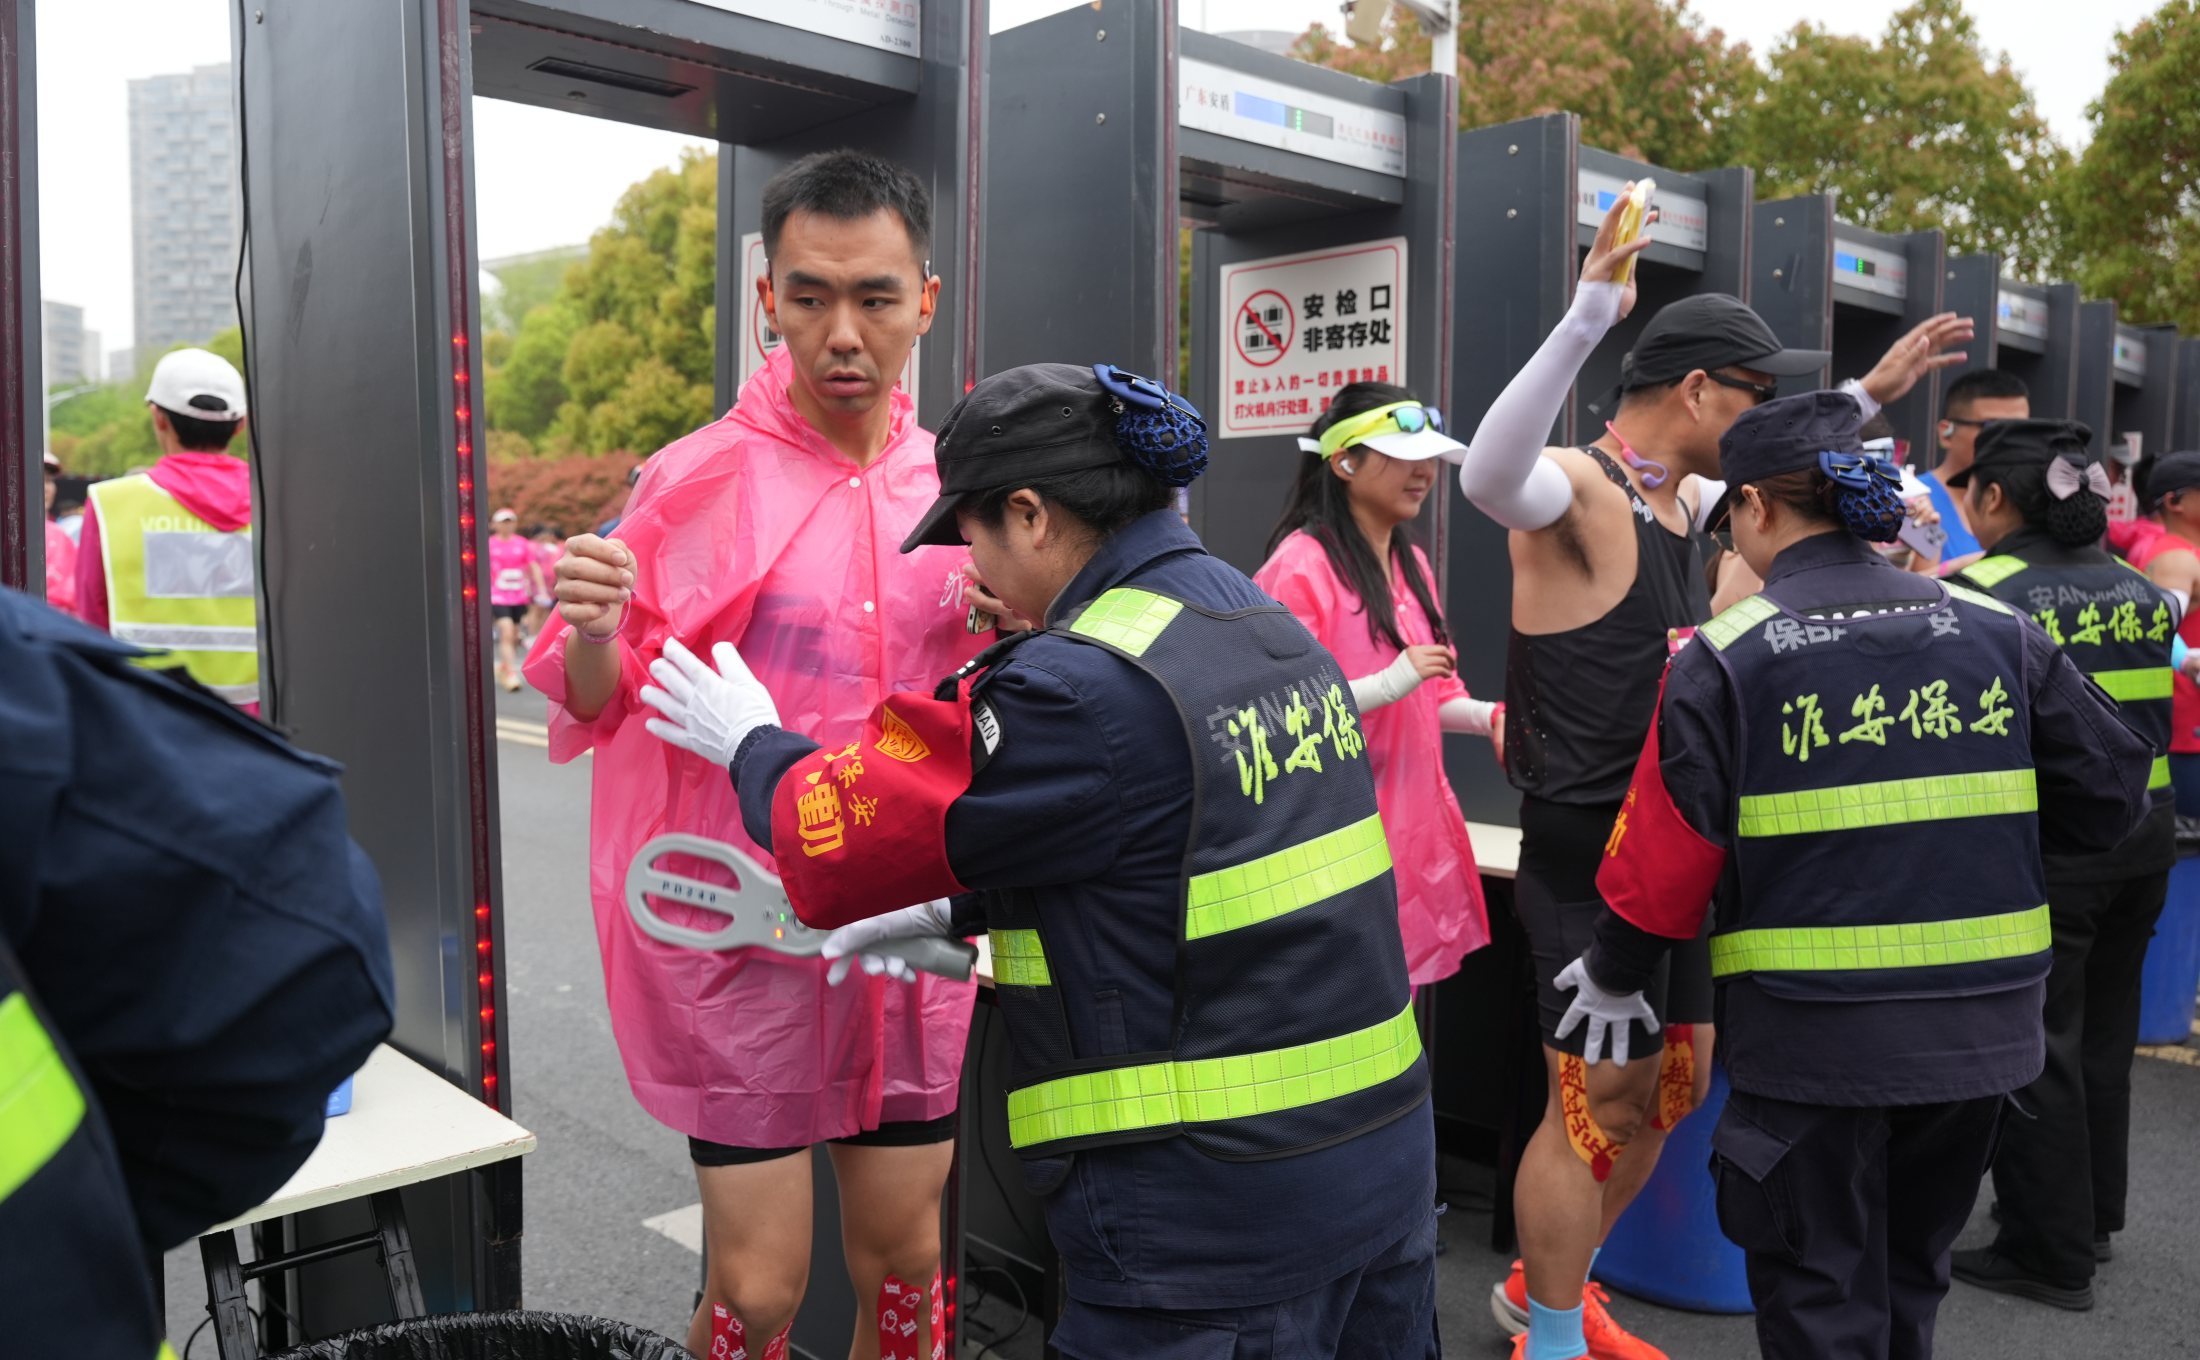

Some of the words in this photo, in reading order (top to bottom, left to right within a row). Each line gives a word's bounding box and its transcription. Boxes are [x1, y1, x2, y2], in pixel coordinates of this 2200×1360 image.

[1303, 284, 1391, 320] 安检口
[1303, 318, 1391, 353] 非寄存处
[1781, 675, 2015, 763] 淮安保安
